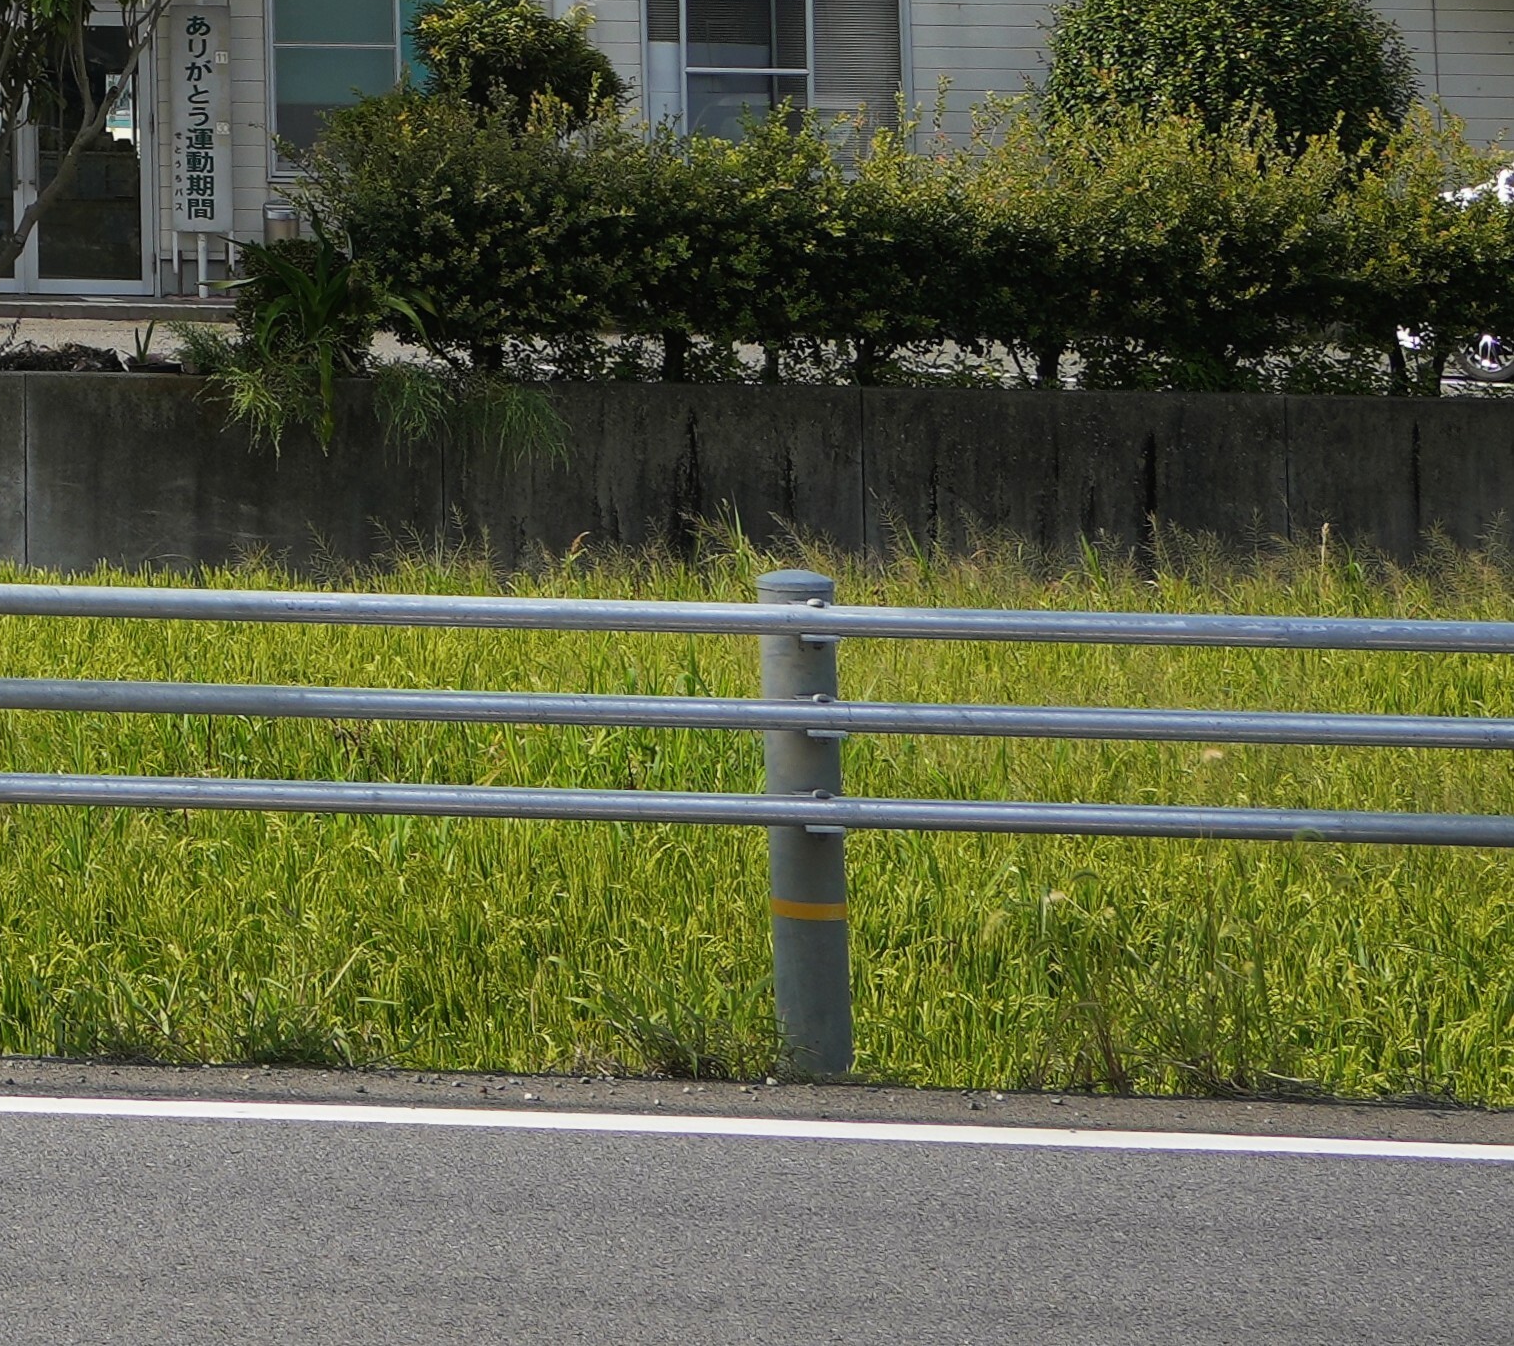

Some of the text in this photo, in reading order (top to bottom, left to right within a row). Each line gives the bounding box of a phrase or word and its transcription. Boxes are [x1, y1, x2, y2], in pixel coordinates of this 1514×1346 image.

[174, 132, 184, 212] せとうちバス
[185, 15, 215, 221] ありがとう運動期間
